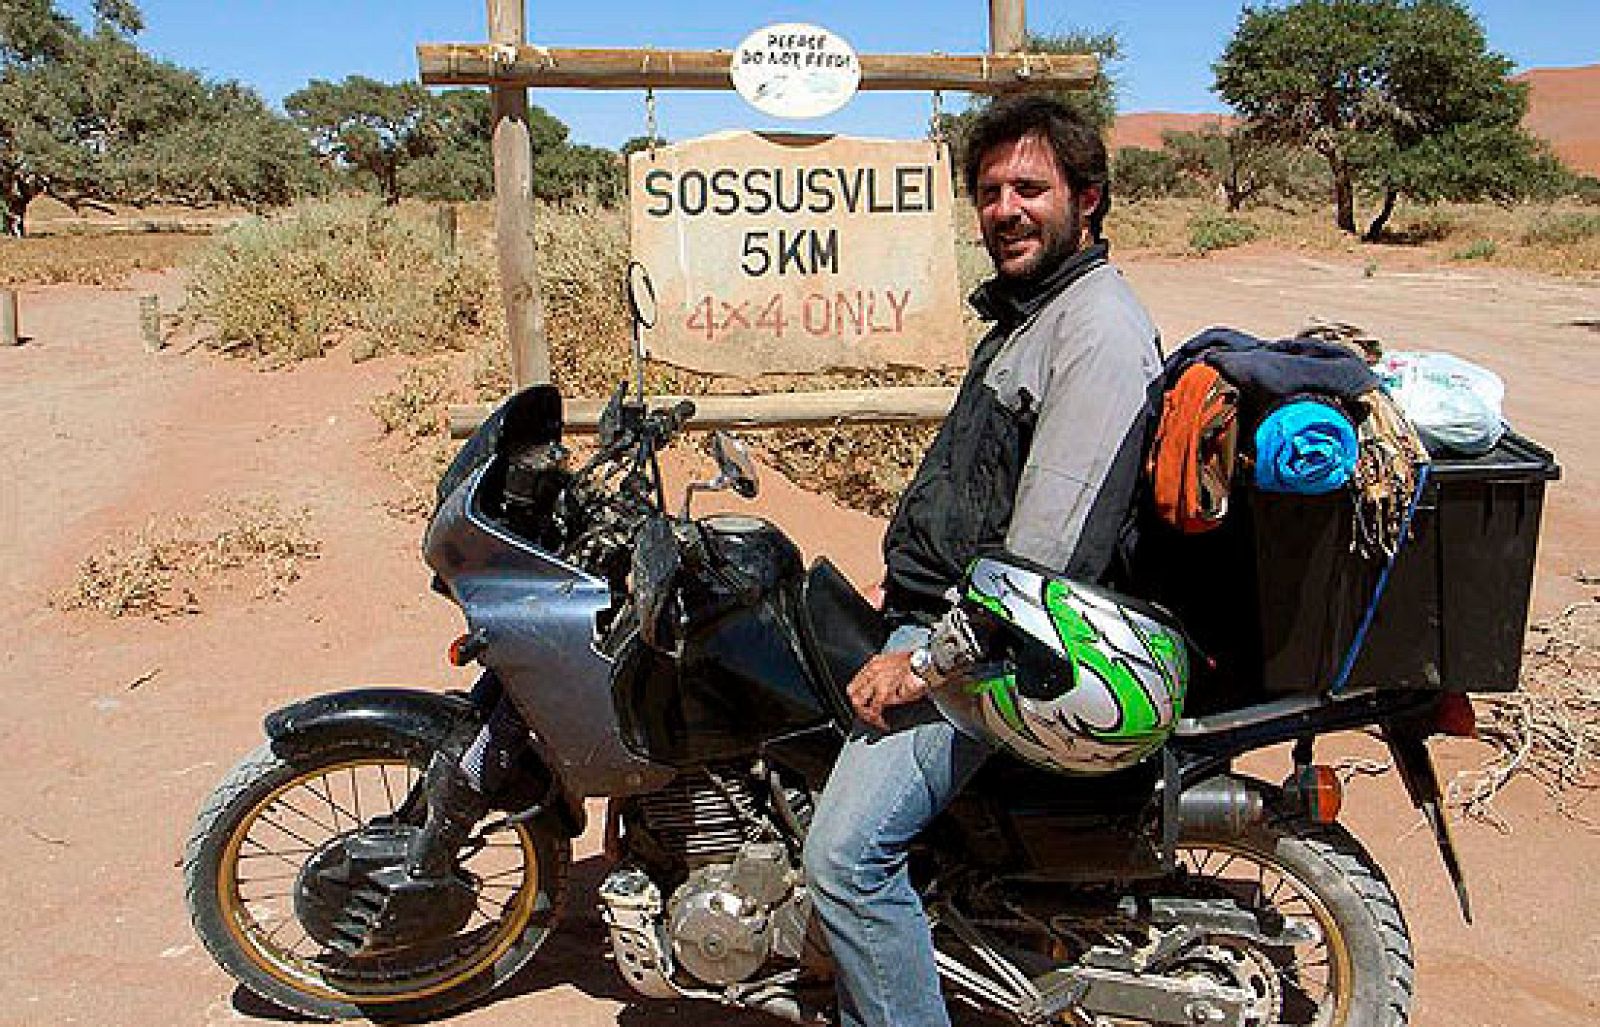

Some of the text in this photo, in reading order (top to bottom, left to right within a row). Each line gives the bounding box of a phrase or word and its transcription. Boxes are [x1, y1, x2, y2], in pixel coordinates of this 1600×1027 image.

[768, 34, 826, 49] PLEASE
[742, 50, 764, 65] DO
[768, 51, 800, 66] NOT
[645, 167, 934, 216] SOSSUSVLEI
[802, 289, 911, 337] ONLY
